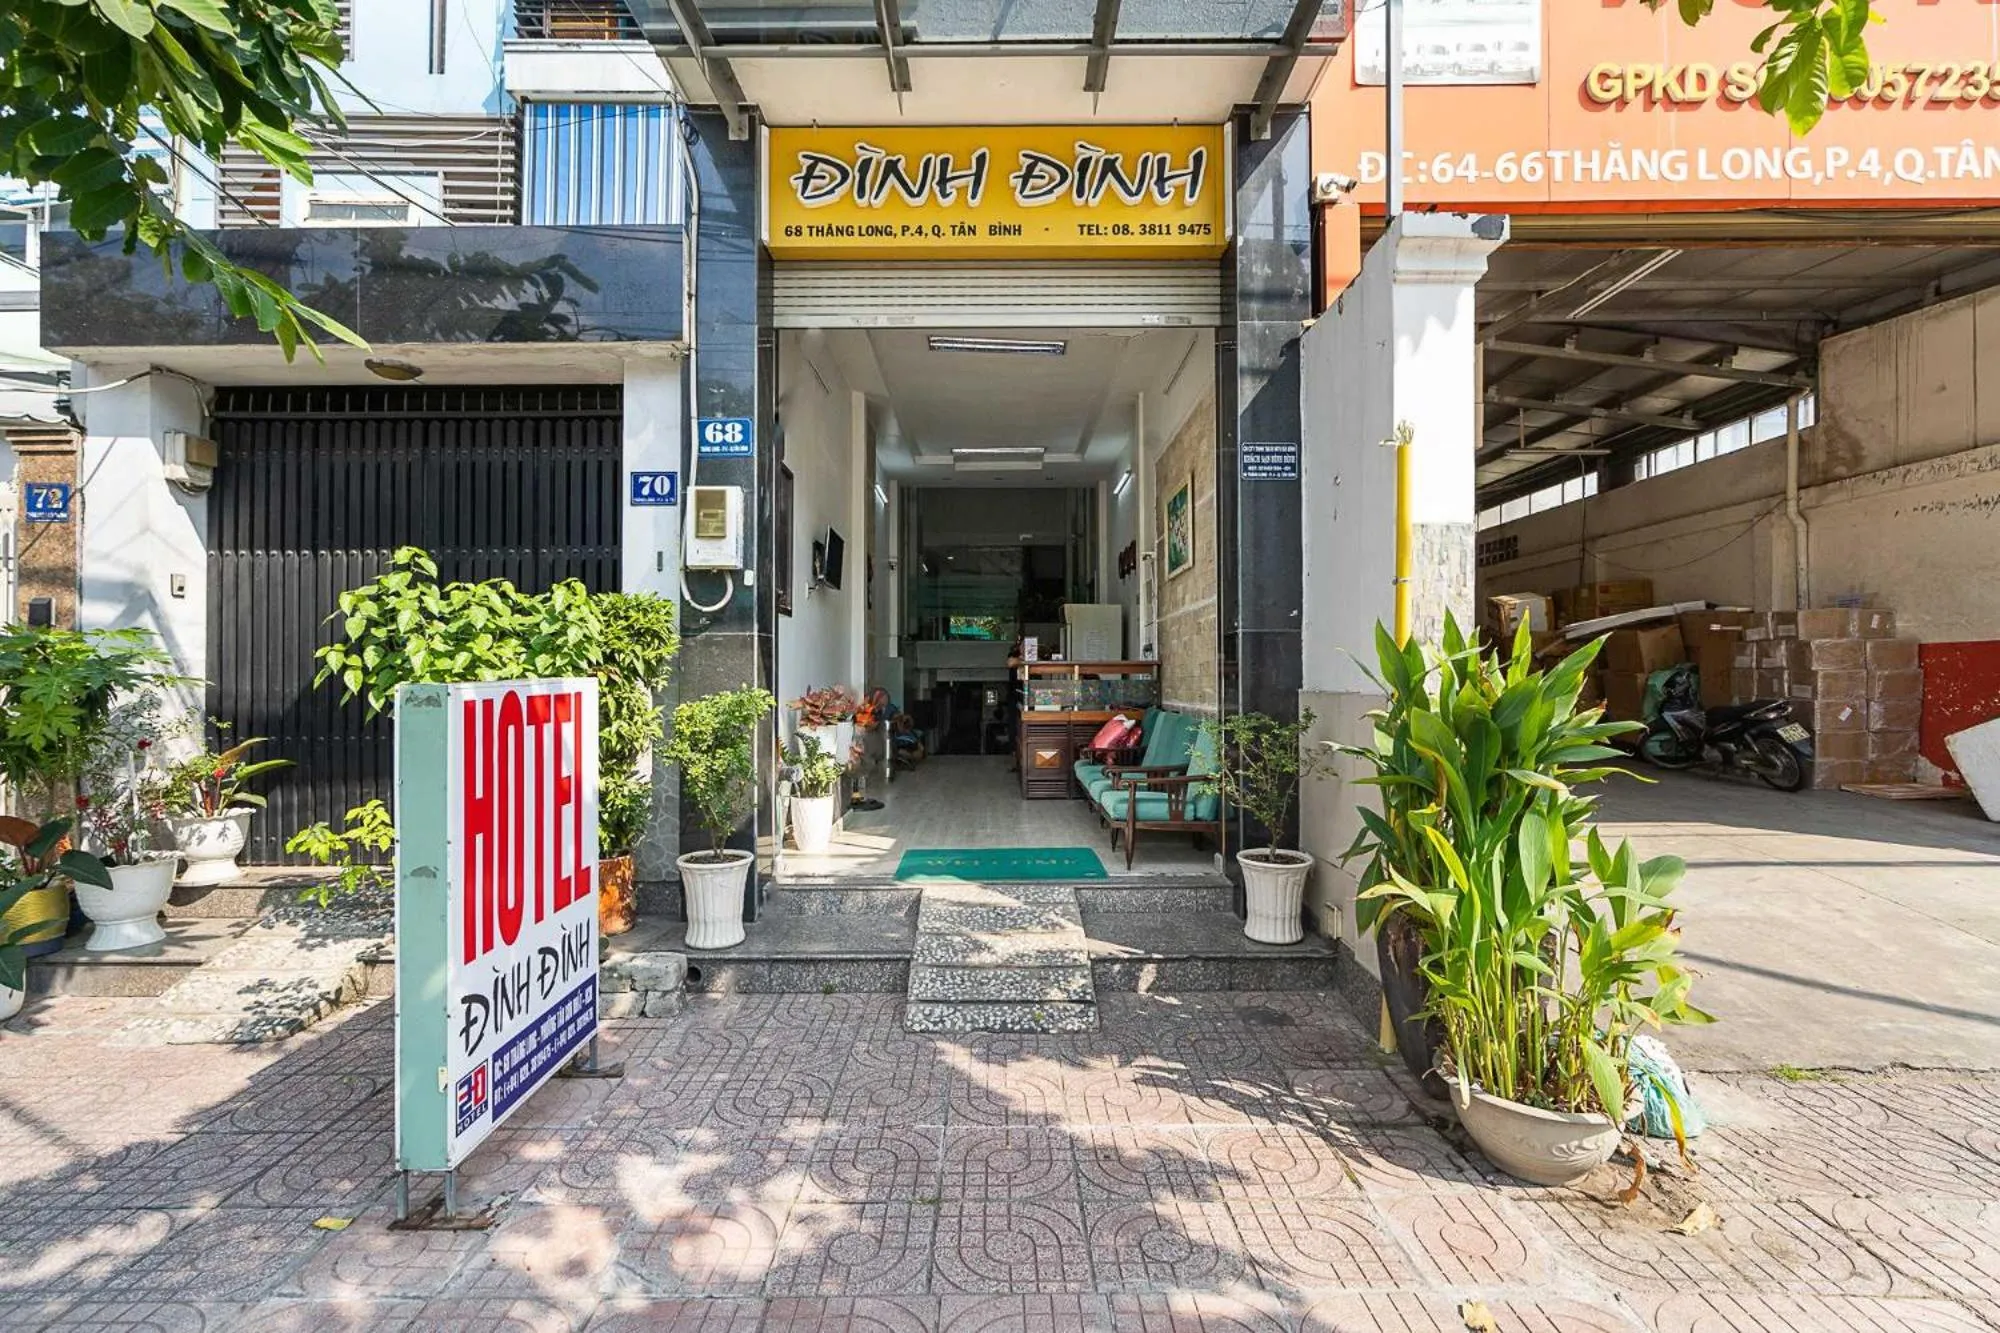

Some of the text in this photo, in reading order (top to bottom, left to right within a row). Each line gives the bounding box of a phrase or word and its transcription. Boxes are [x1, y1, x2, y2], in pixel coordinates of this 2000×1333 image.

[1587, 62, 1719, 103] GPKD
[1724, 62, 1768, 101] S
[791, 141, 1207, 207] ĐÌNH ĐÌNH
[784, 225, 803, 237] 68
[858, 225, 897, 239] LONG,
[988, 222, 1022, 237] BÌNH
[1078, 223, 1108, 236] TEL:
[1112, 223, 1135, 236] 08.
[1139, 223, 1171, 236] 3811
[1178, 223, 1211, 236] 9475
[705, 422, 744, 443] 68
[32, 488, 63, 508] 72
[638, 475, 670, 495] 70
[464, 690, 590, 965] HOTEL
[460, 918, 590, 1057] ĐÌNH ĐÌNH
[456, 1103, 487, 1134] HOTEL
